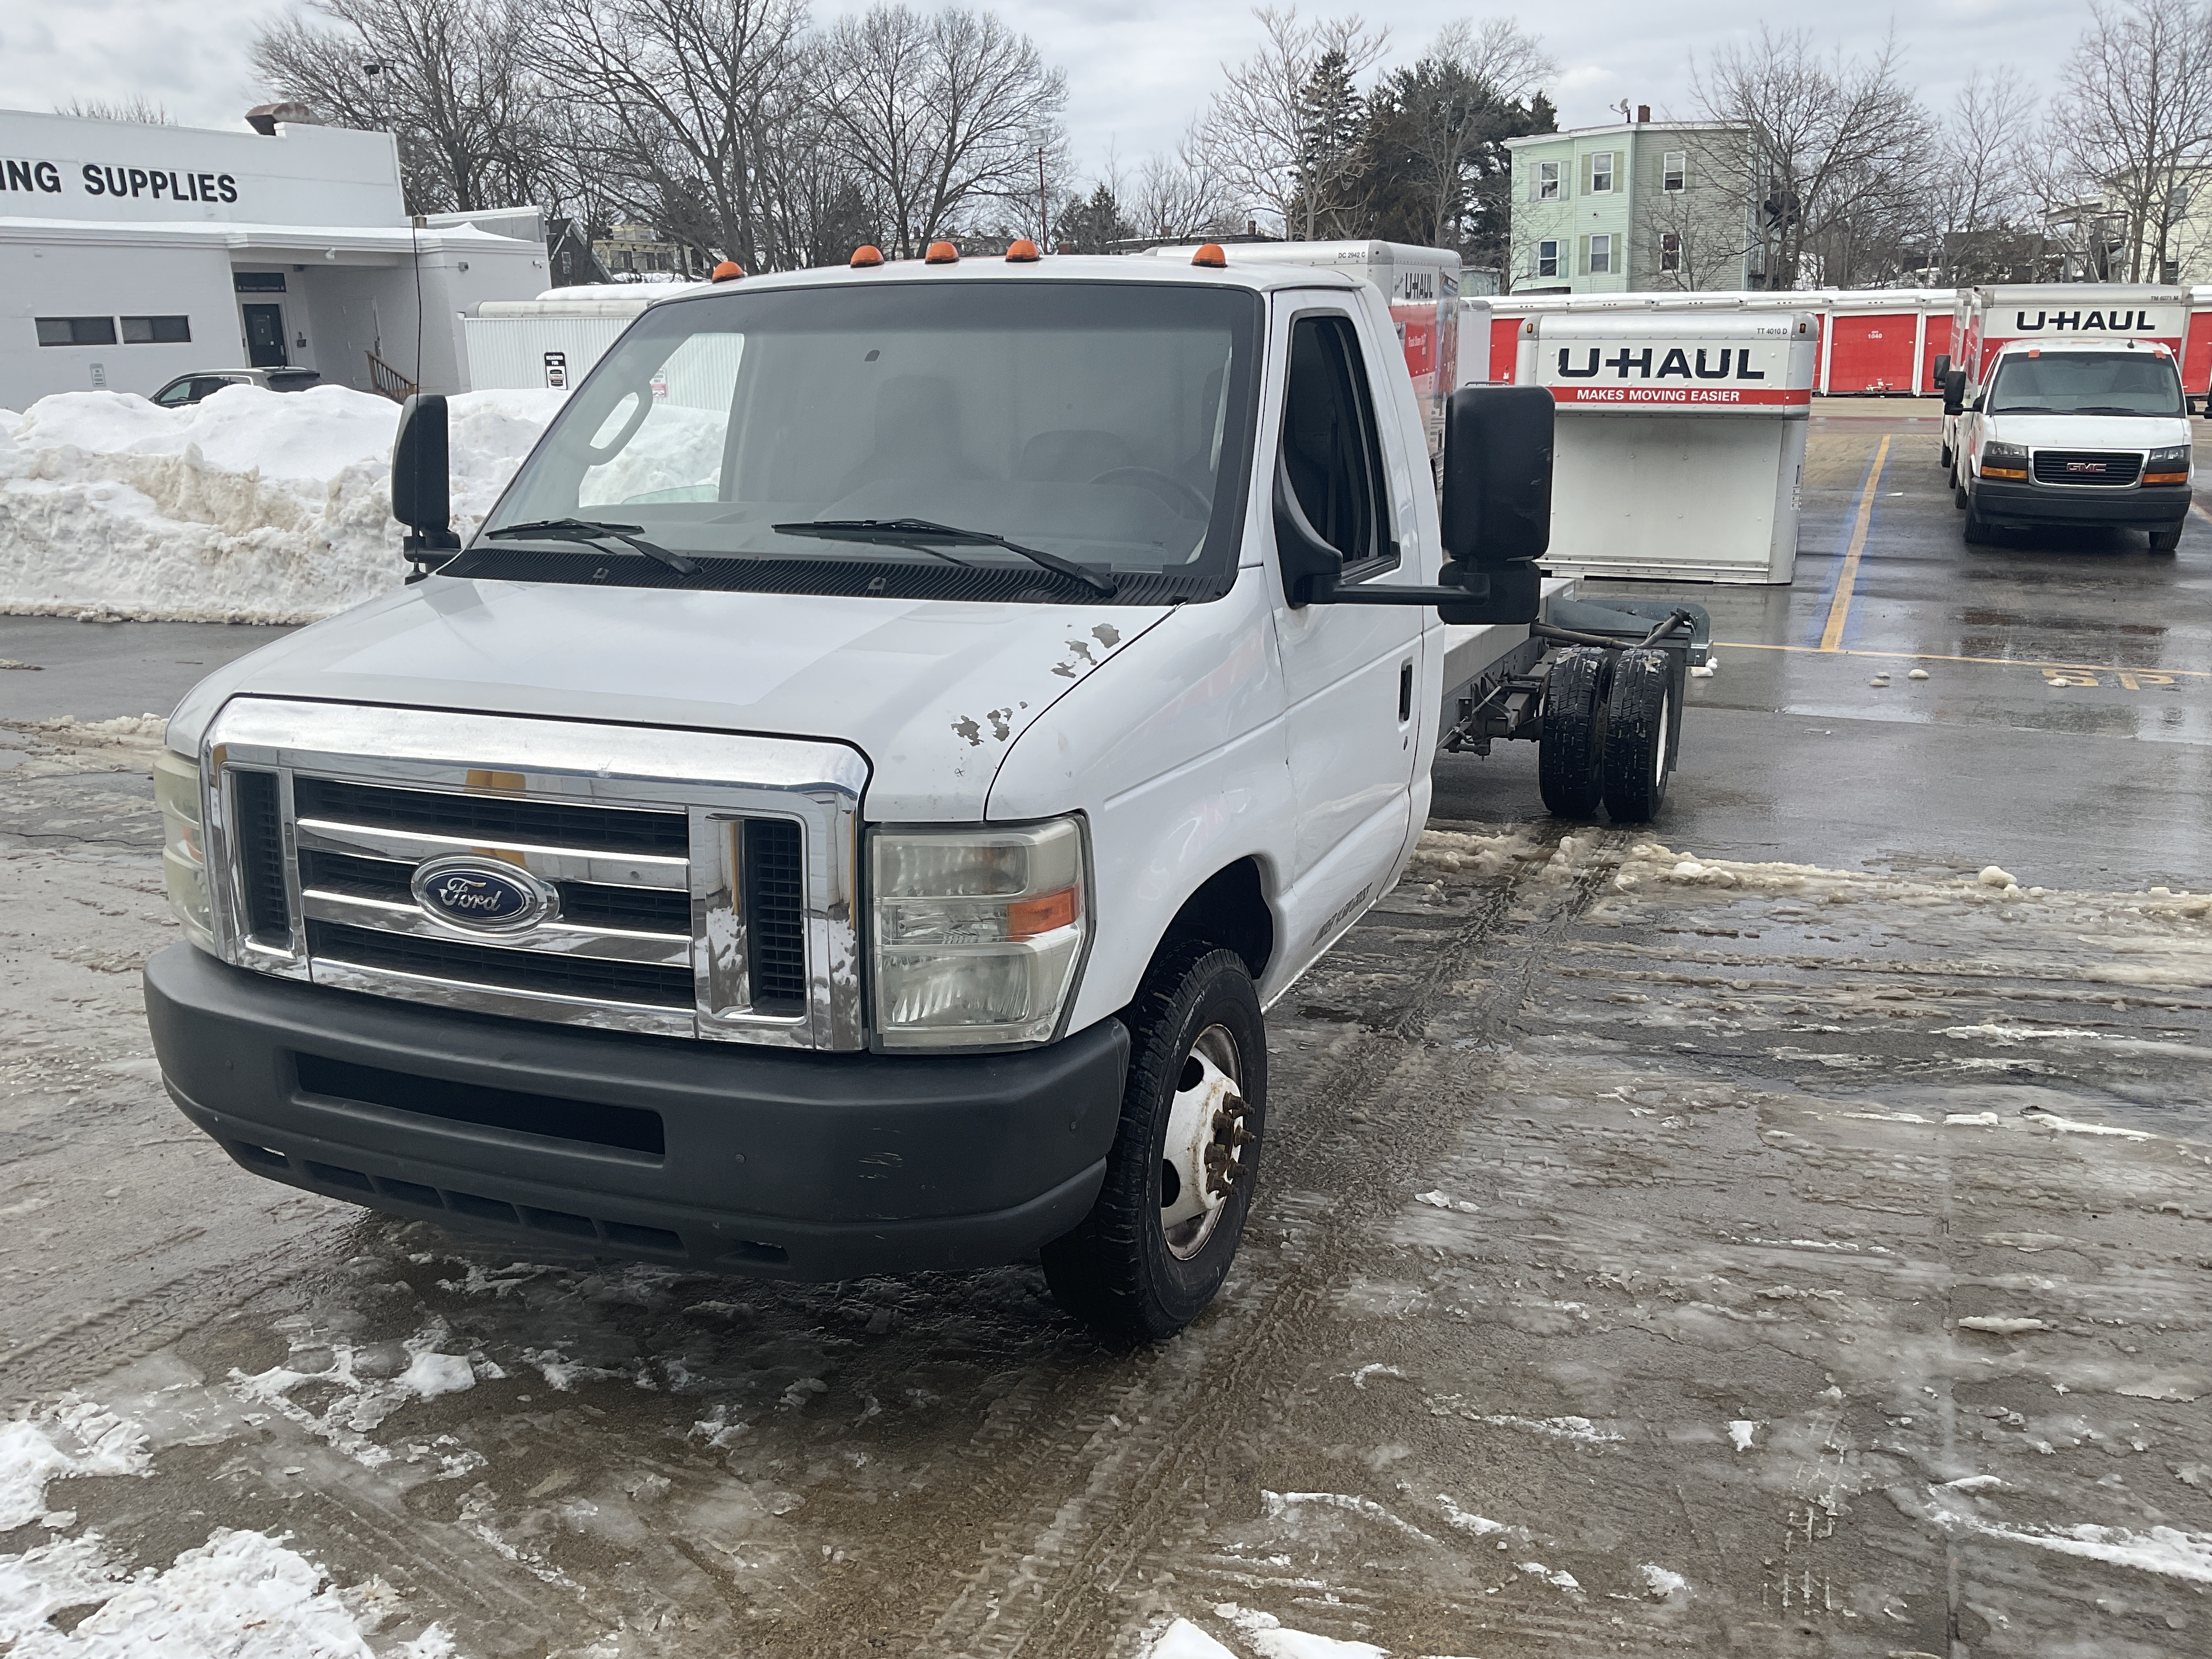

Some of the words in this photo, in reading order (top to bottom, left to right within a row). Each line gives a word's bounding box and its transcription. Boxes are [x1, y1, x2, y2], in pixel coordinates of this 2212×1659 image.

[82, 164, 238, 203] SUPPLIES
[1406, 272, 1432, 299] U-HAUL
[2017, 311, 2155, 330] U-HAUL
[1558, 348, 1765, 380] U-HAUL
[1576, 390, 1624, 400] MAKES
[1628, 390, 1686, 402] MOVING
[1690, 391, 1740, 402] EASIER
[2067, 462, 2107, 473] GMC
[438, 877, 502, 912] Ford
